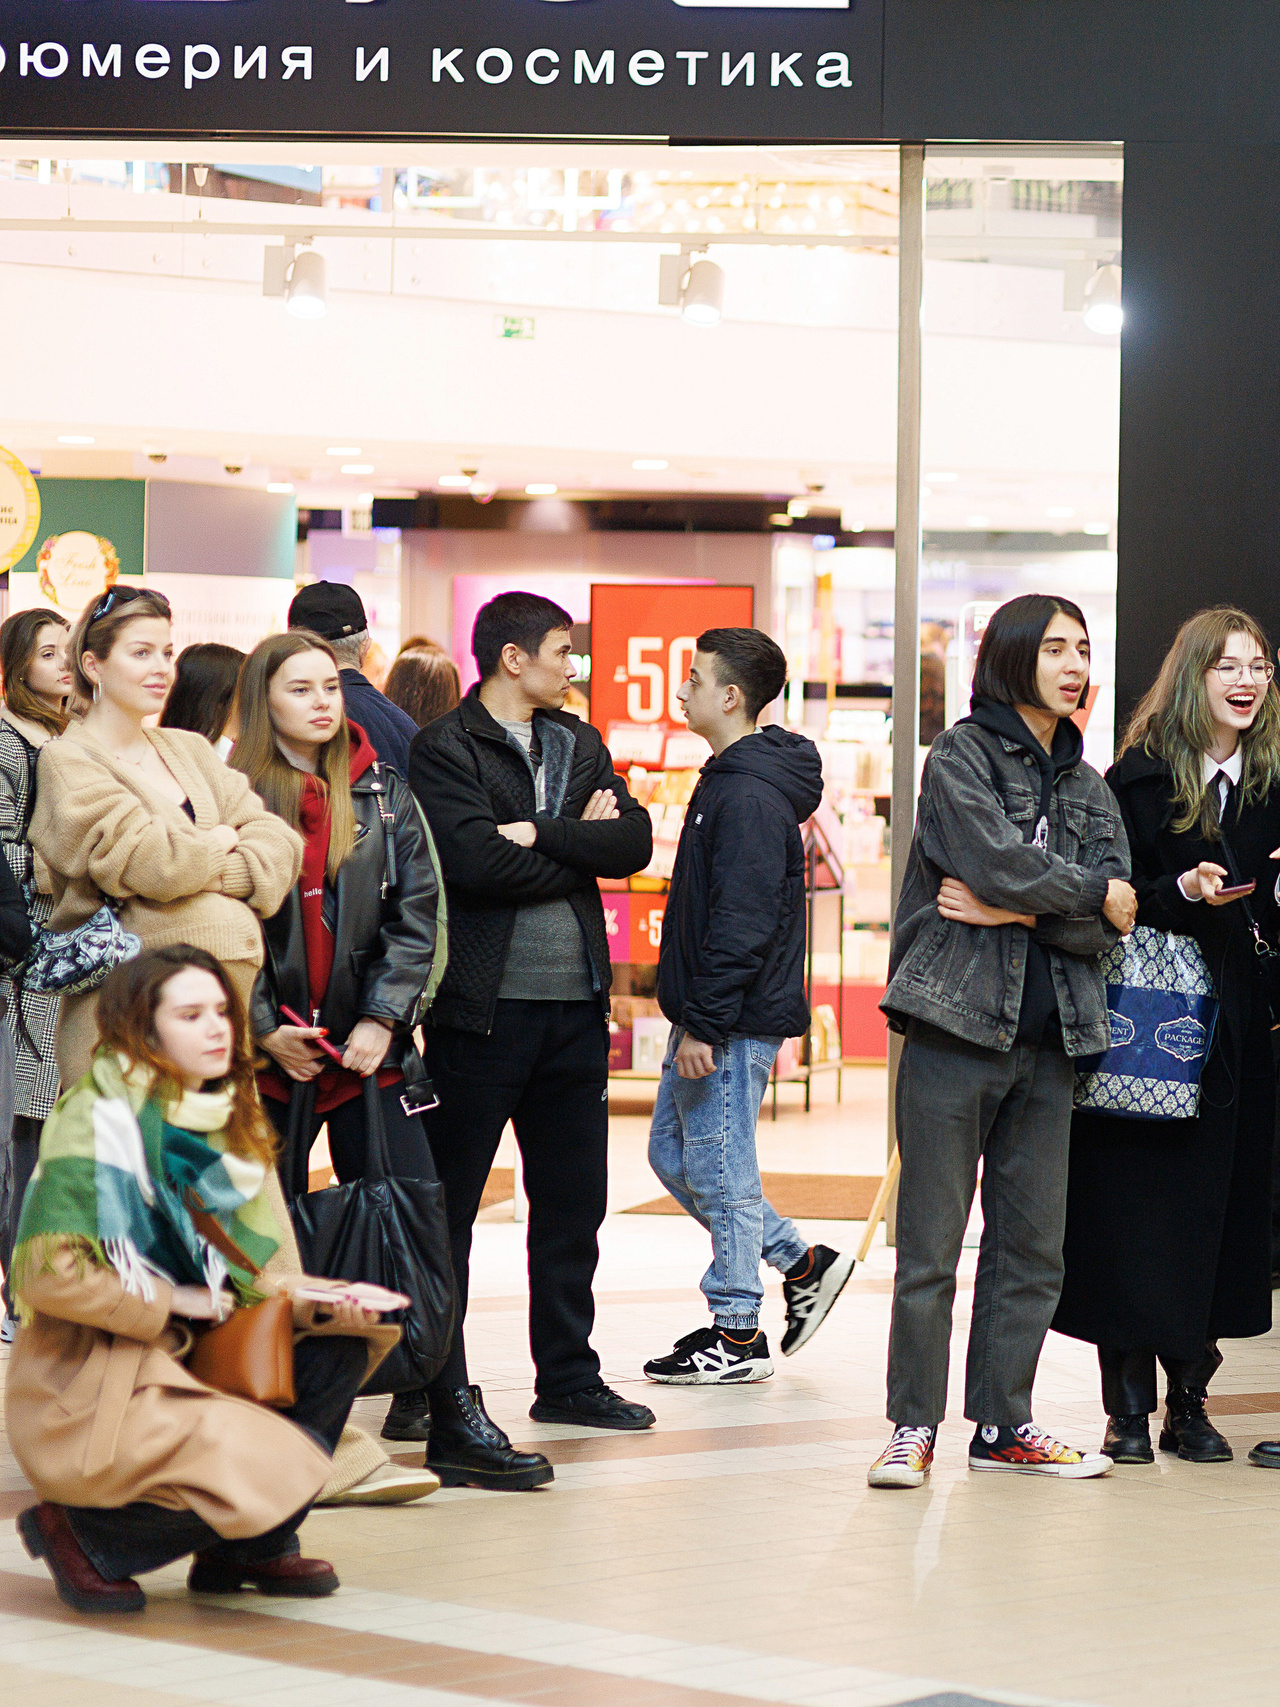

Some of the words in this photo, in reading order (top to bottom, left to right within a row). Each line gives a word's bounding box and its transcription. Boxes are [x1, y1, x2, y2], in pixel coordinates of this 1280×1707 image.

[0, 42, 313, 89] юмерия
[355, 46, 389, 82] и
[431, 47, 852, 88] косметика
